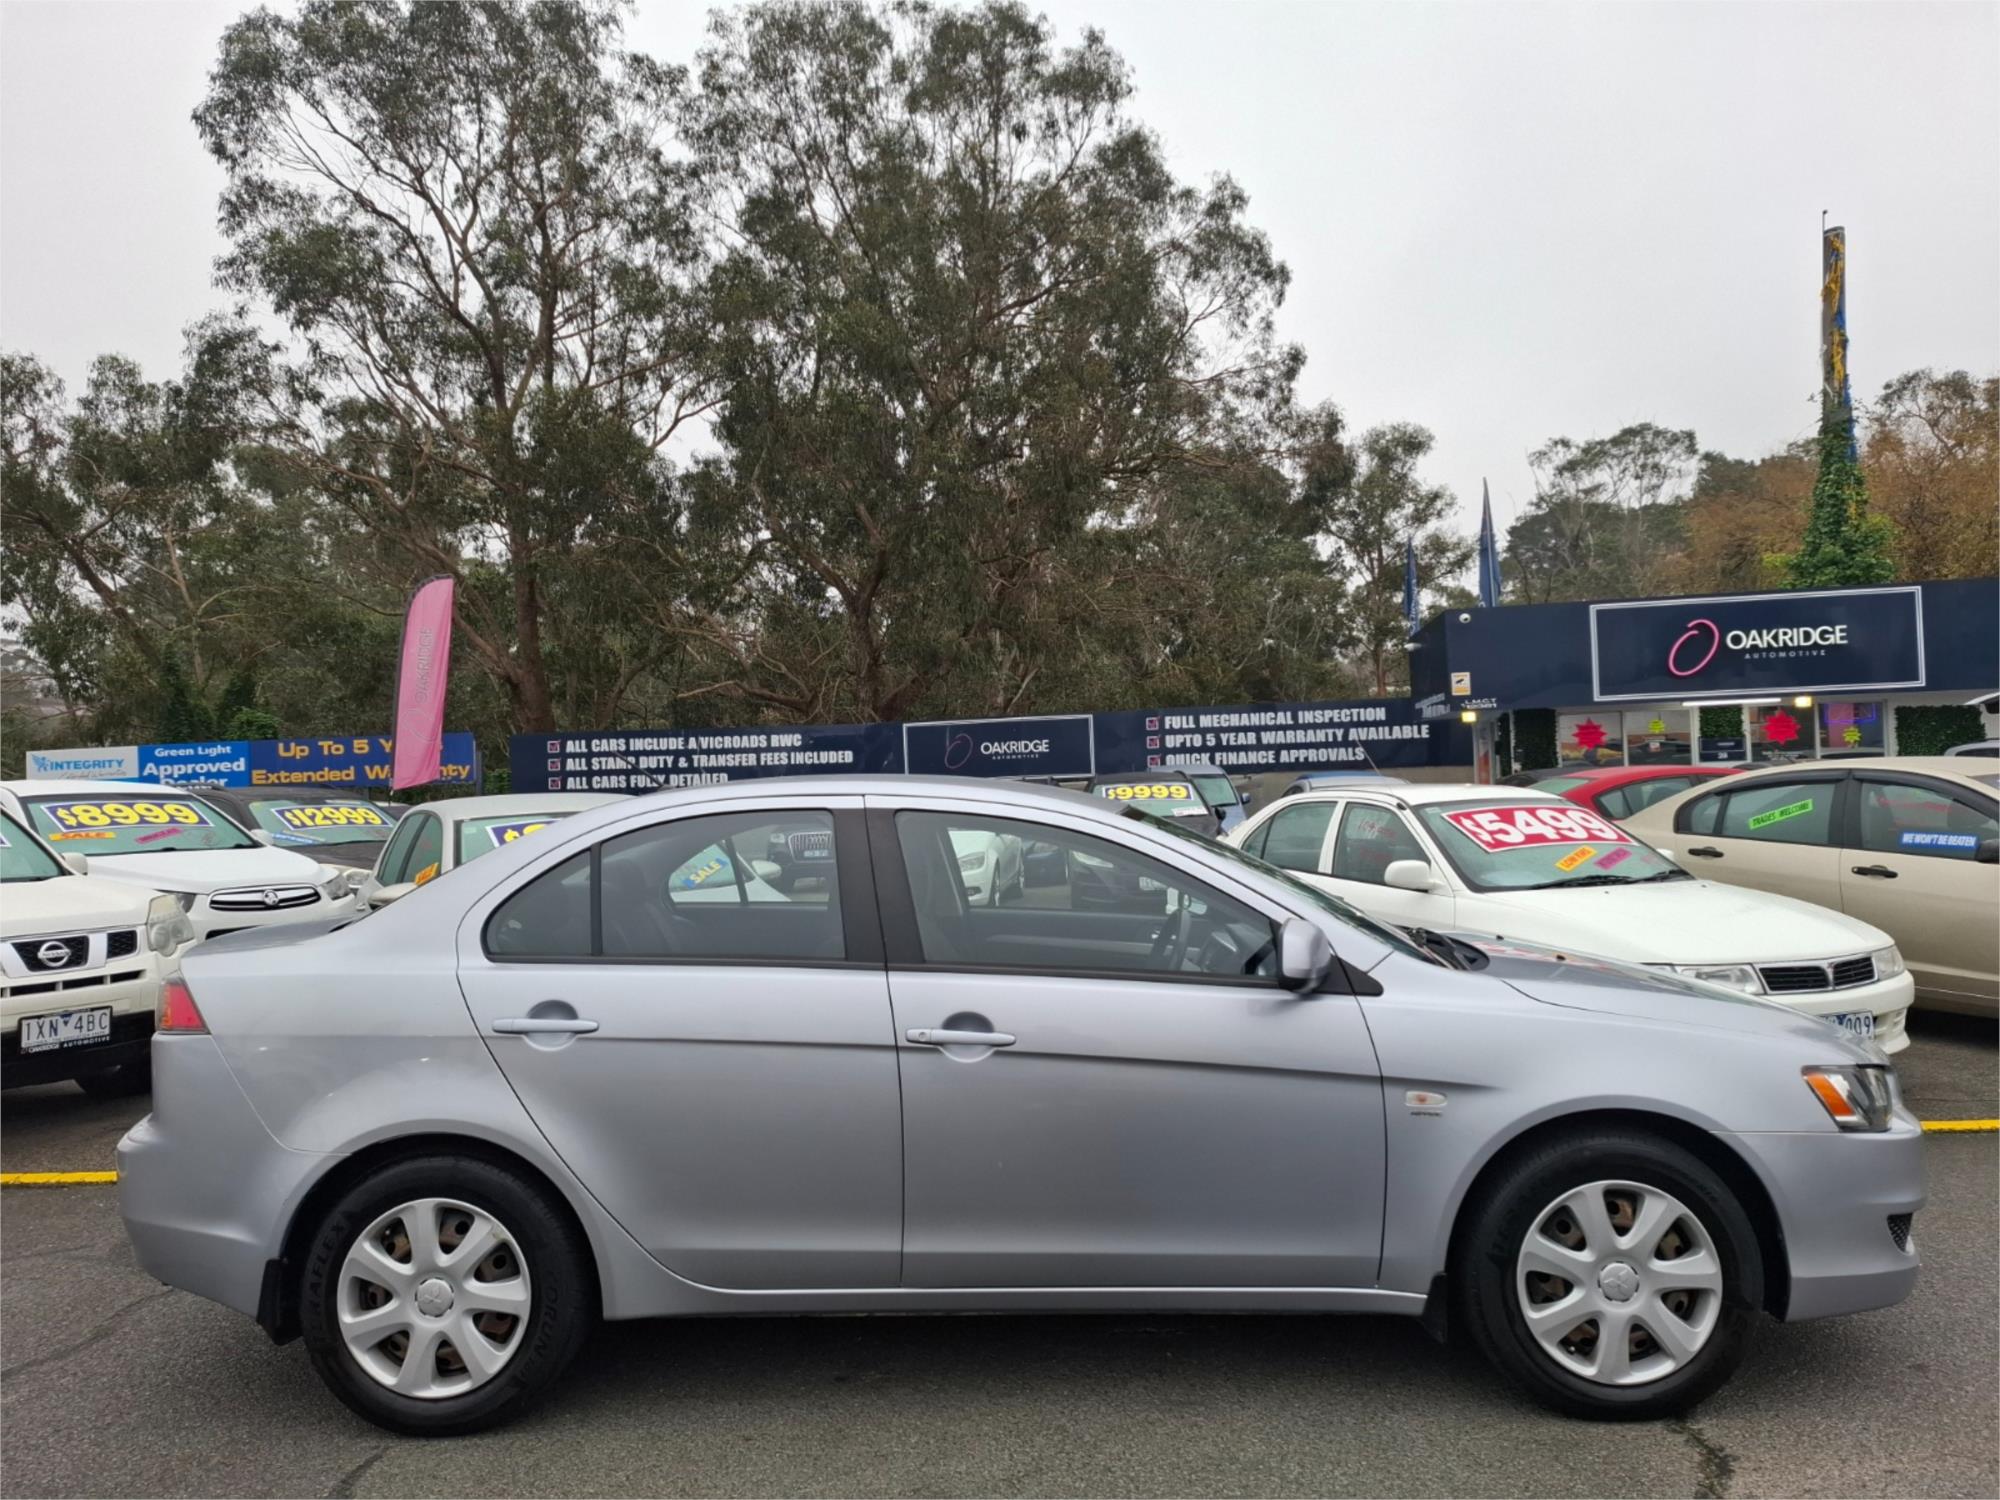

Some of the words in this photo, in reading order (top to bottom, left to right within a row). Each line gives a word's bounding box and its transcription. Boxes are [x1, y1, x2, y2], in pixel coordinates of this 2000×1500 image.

[1726, 625, 1848, 650] OAKRIDGE
[1745, 650, 1826, 660] AUTOMOTIVE
[1164, 715, 1196, 729] FULL
[1200, 711, 1294, 728] MECHANICAL
[1298, 707, 1386, 724] INSPECTION
[566, 740, 588, 753] ALL
[591, 739, 626, 752] CARS
[629, 737, 684, 751] INCLUDE
[688, 737, 697, 750] A
[699, 735, 767, 750] VICROADS
[771, 734, 802, 748] RWC
[1165, 734, 1203, 748] UPTO
[1206, 733, 1216, 746] 5
[1220, 731, 1257, 746] YEAR
[1261, 728, 1344, 745] WARRANTY
[1348, 724, 1430, 741] AVAILABLE
[155, 748, 193, 757] Green
[198, 745, 231, 757] Light
[278, 742, 309, 759] Up
[318, 741, 344, 754] To
[353, 739, 369, 754] 5
[980, 739, 1050, 755] OAKRIDGE
[1165, 752, 1210, 766] QUICK
[1215, 750, 1276, 766] FINANCE
[1279, 747, 1365, 763] APPROVALS
[51, 759, 124, 770] INTEGRITY
[143, 758, 245, 778] Approved
[566, 758, 588, 771] ALL
[591, 756, 636, 770] STAMP
[639, 755, 674, 769] DUTY
[678, 756, 688, 768] &
[692, 753, 757, 767] TRANSFER
[760, 752, 788, 766] FEES
[791, 750, 853, 765] INCLUDED
[252, 766, 355, 784] Extended
[566, 776, 588, 789] ALL
[592, 775, 627, 789] CARS
[630, 774, 665, 788] FULLY
[669, 773, 729, 787] DETAILED
[1107, 785, 1188, 799] $9999
[57, 804, 199, 826] $8999
[284, 807, 382, 826] $12999
[1460, 809, 1618, 844] $5499
[1949, 835, 1976, 847] BEATEN
[689, 860, 721, 884] SALE
[26, 1018, 59, 1041] 1XN
[74, 1012, 107, 1032] 4BC
[63, 1036, 110, 1048] AUTOMOTIVE
